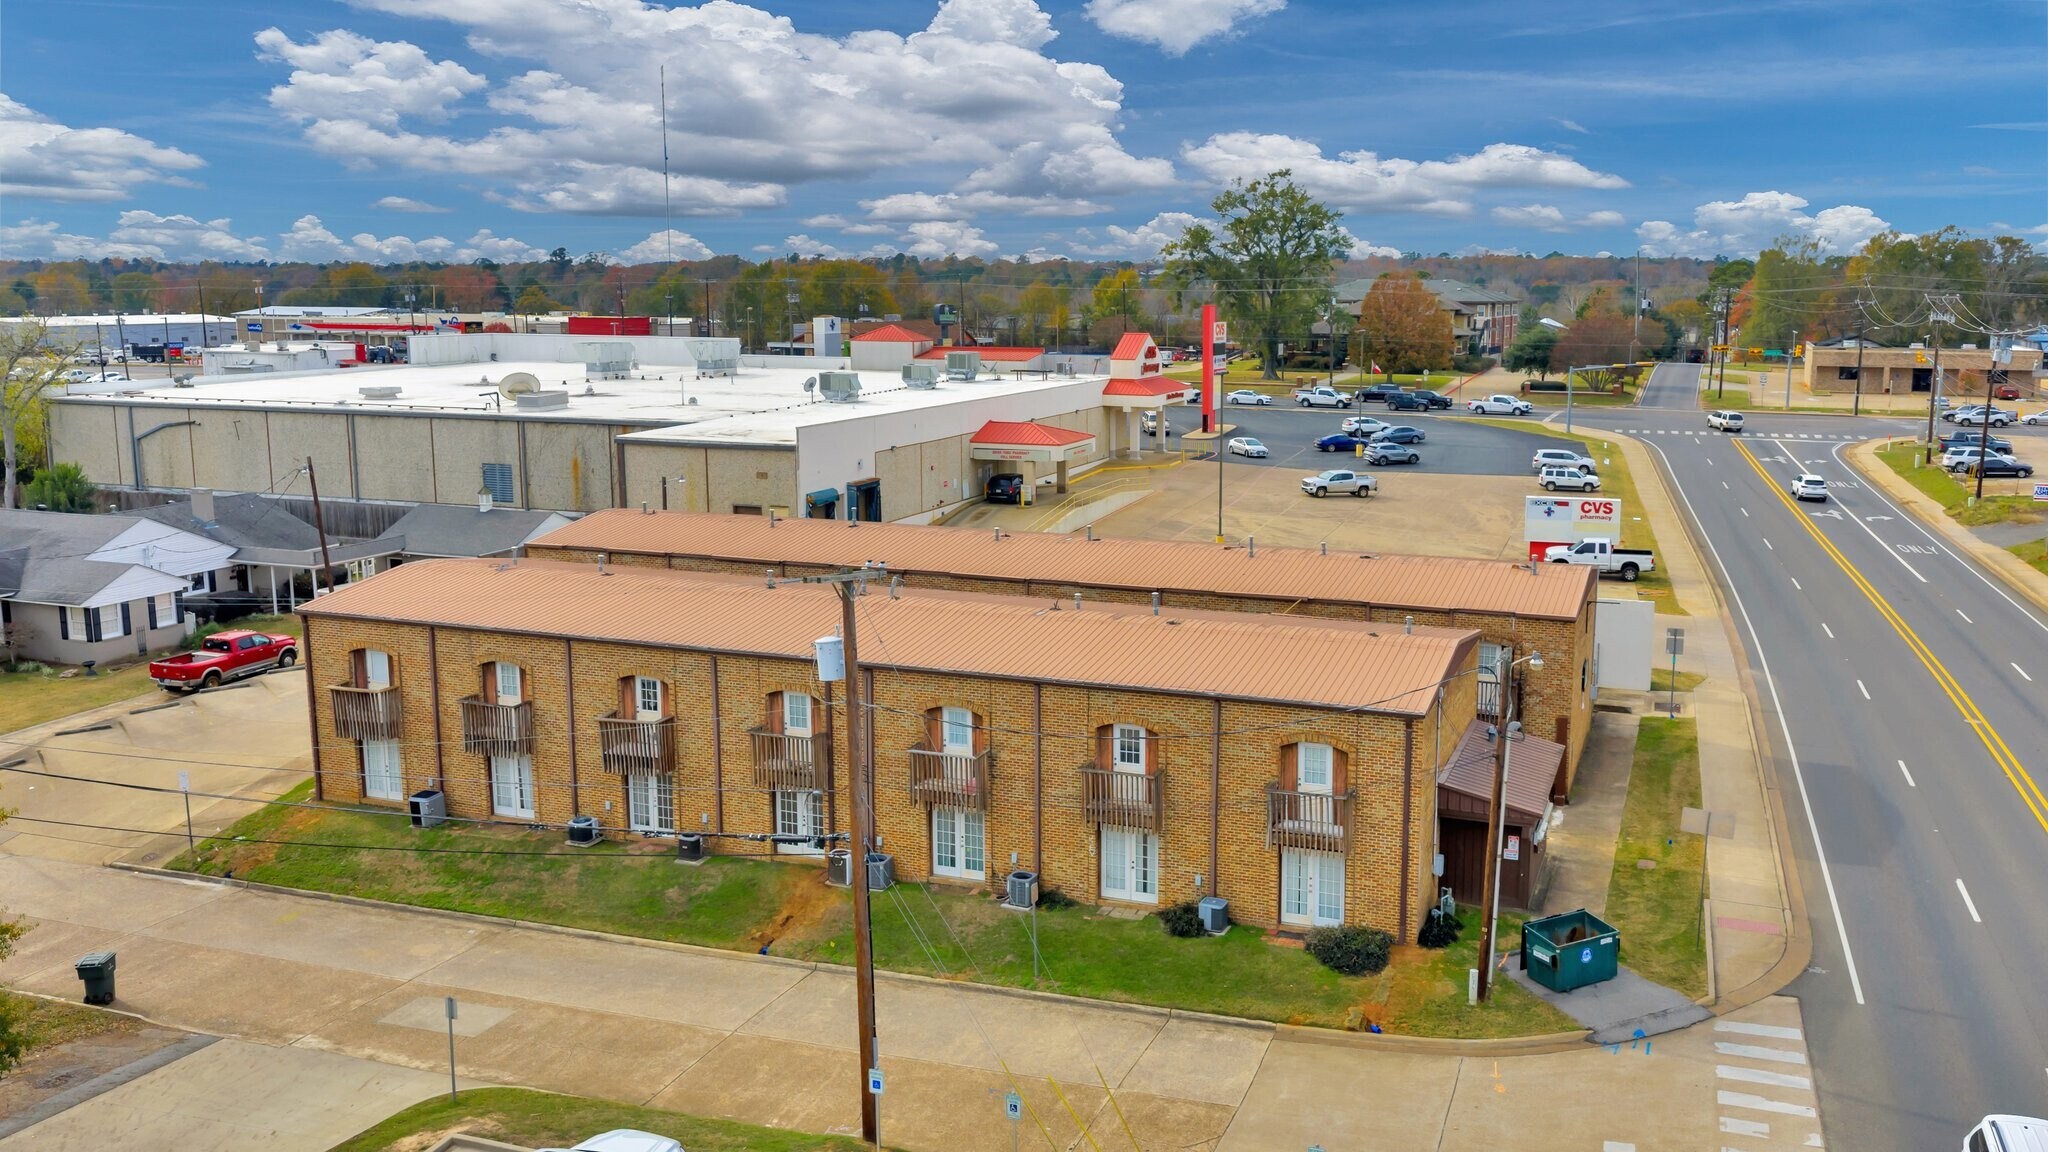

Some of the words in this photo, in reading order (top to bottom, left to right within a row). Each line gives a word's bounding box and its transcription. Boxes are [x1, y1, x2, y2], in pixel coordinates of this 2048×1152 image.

[1215, 323, 1225, 336] CVS
[1580, 501, 1614, 514] CVS
[1896, 544, 1939, 555] ONLY
